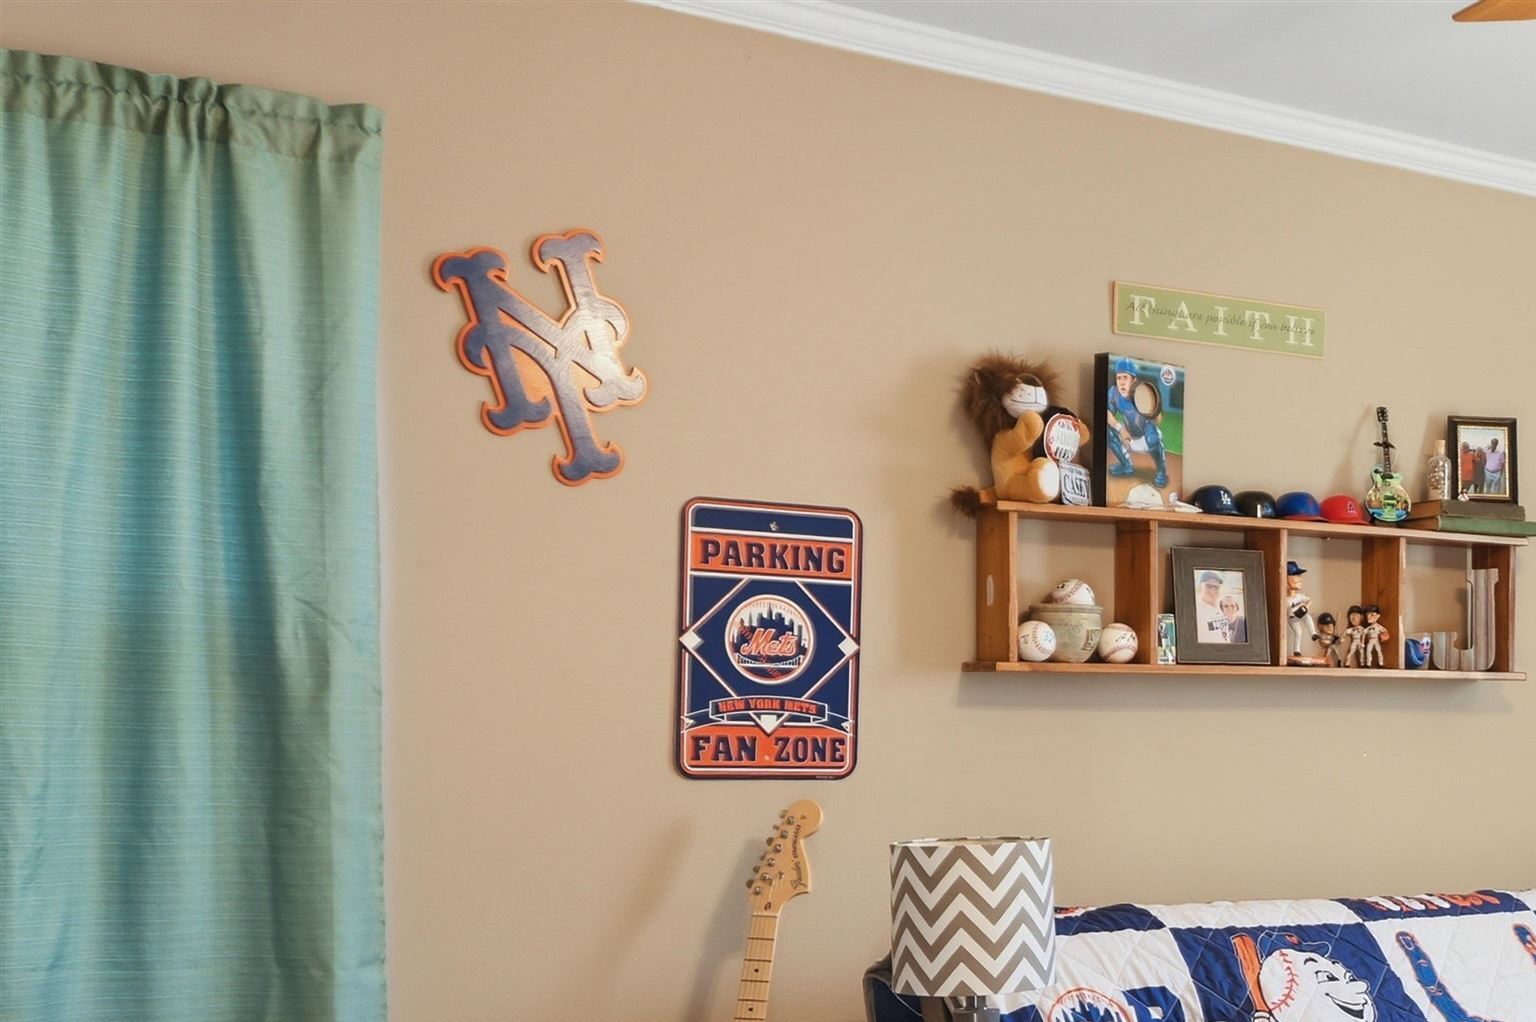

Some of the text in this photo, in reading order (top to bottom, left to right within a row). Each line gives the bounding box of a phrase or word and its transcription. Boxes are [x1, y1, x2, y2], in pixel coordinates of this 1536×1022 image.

[1129, 294, 1315, 347] FAITH
[1219, 490, 1232, 505] LA
[700, 538, 845, 573] PARKING
[740, 628, 798, 656] Mets
[718, 697, 818, 713] NEW YORK METS
[690, 735, 846, 763] FAN ZONE
